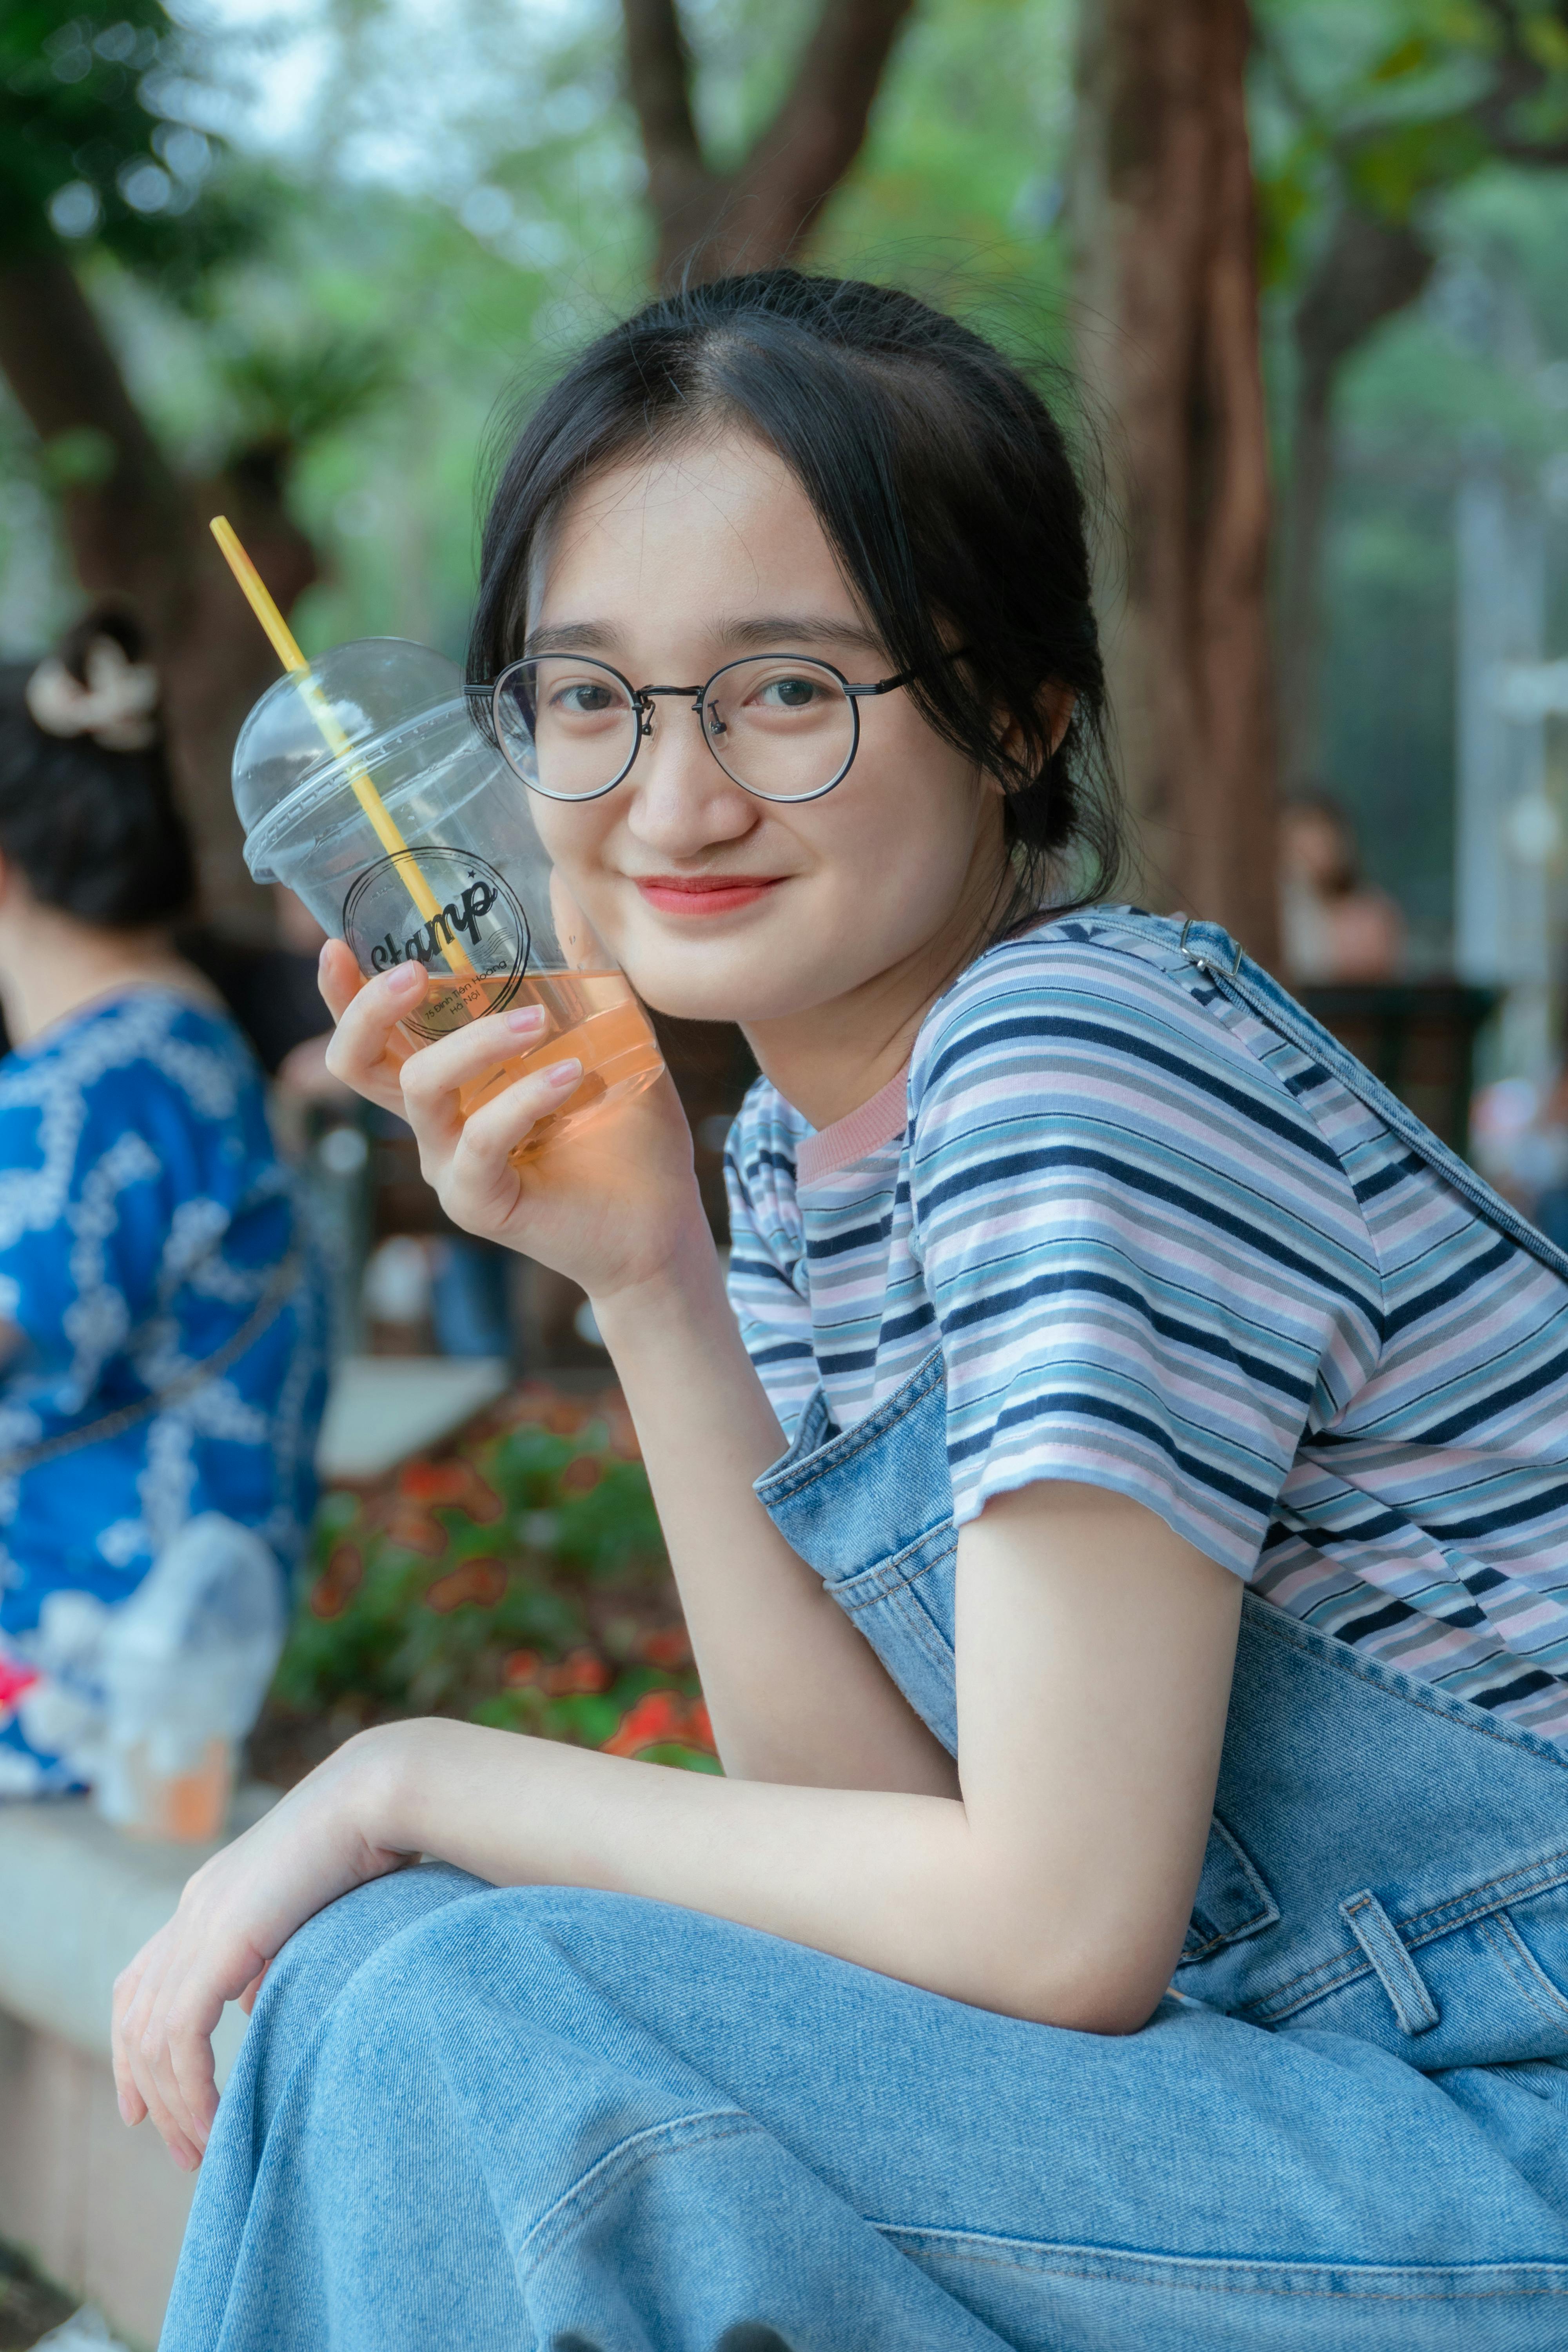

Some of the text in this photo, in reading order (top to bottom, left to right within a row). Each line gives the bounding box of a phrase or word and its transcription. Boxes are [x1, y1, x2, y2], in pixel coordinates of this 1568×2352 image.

[425, 960, 507, 1020] 75 Đinh Tiên Hoàng
[450, 990, 480, 1014] Hà Nội
